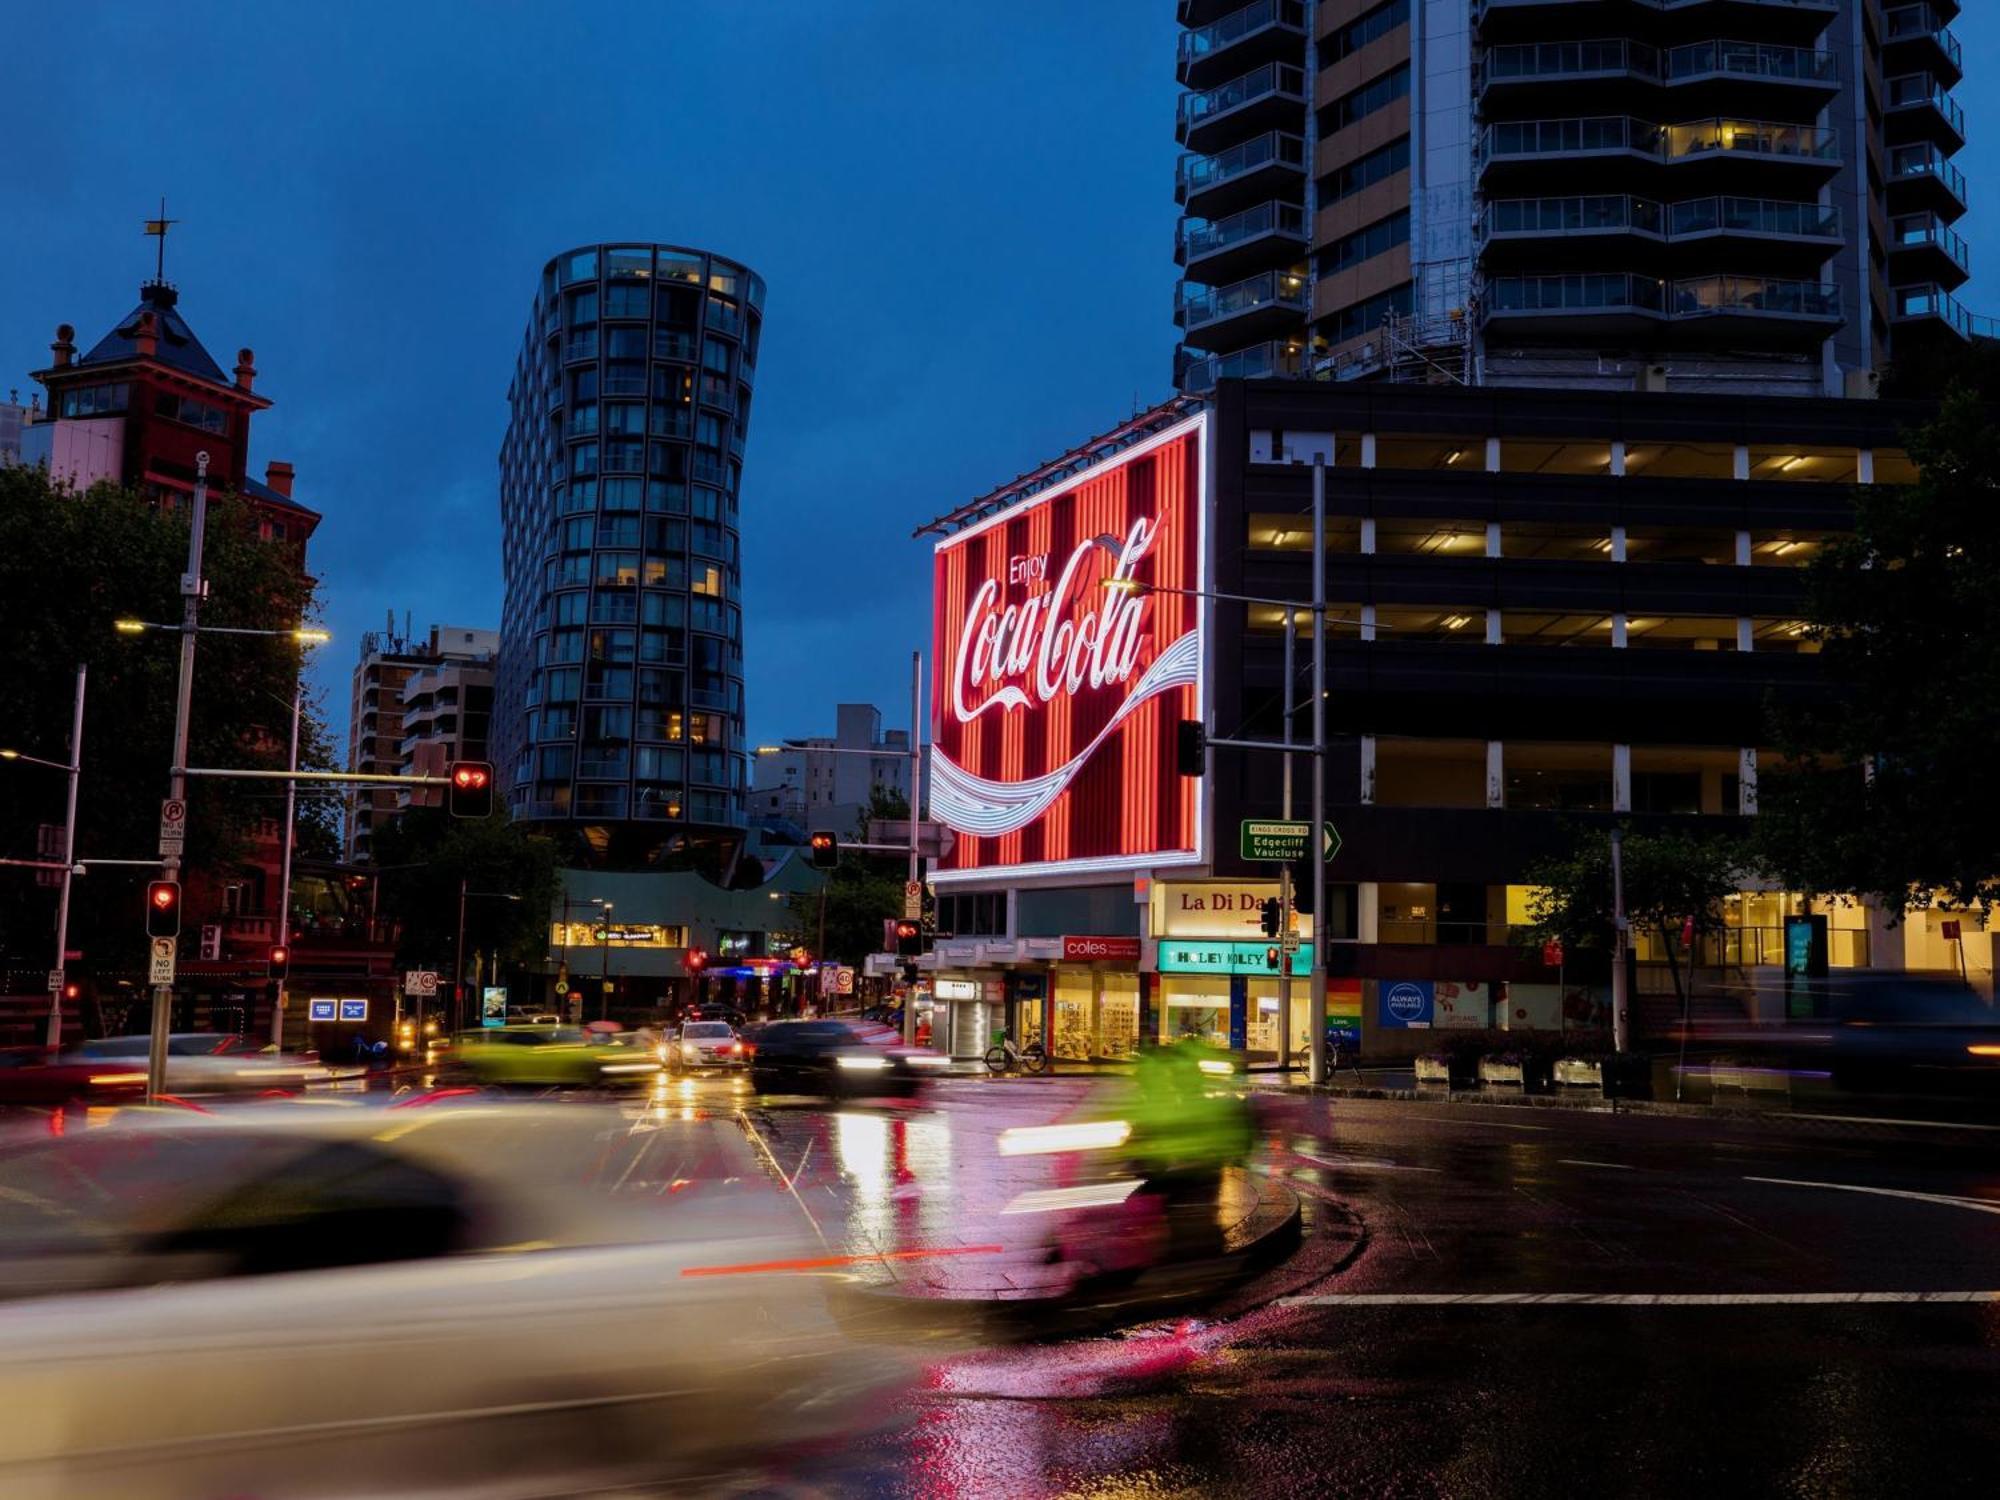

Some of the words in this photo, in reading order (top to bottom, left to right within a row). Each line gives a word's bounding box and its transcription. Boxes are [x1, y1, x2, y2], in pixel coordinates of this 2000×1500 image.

[1009, 552, 1048, 585] Enjoy
[953, 509, 1164, 723] Coca-Cola
[1297, 827, 1308, 835] RD
[1253, 837, 1304, 849] Edgecliff
[1253, 848, 1305, 858] Vaucluse
[1181, 893, 1206, 910] La
[1211, 893, 1232, 910] Di
[1067, 939, 1108, 955] coles
[155, 959, 170, 969] NO
